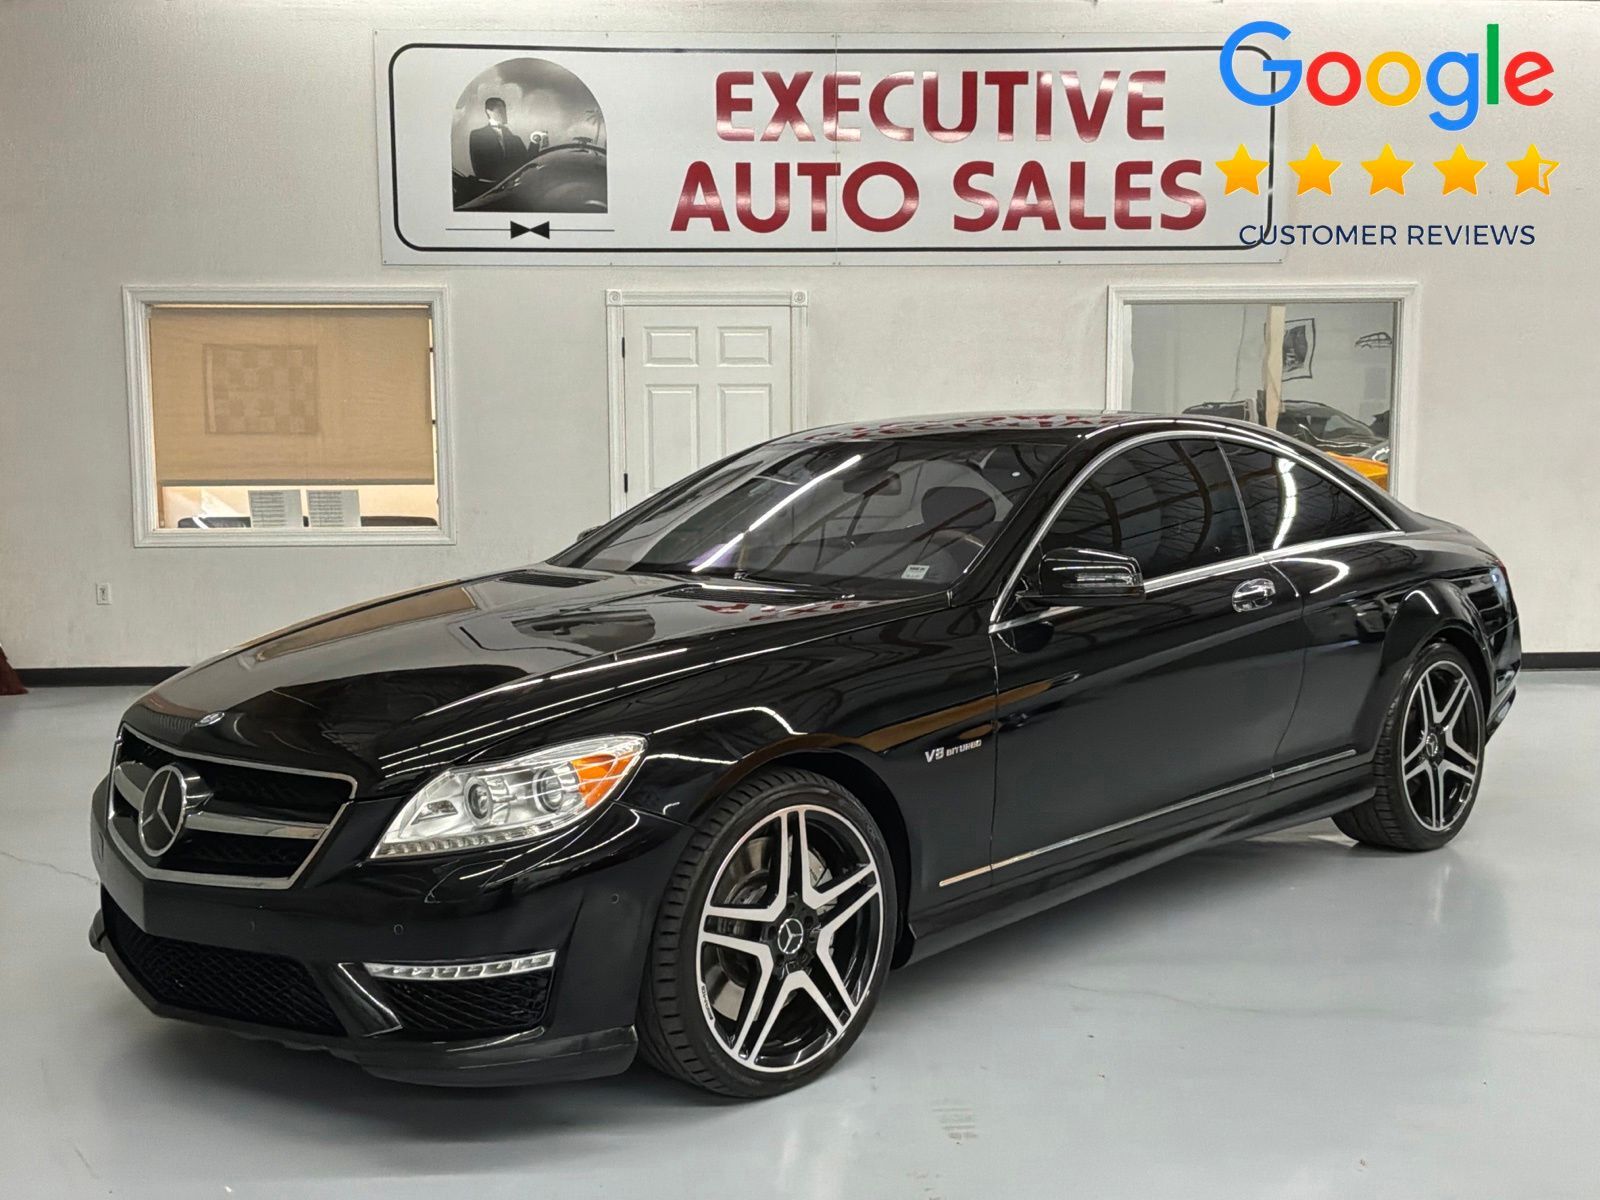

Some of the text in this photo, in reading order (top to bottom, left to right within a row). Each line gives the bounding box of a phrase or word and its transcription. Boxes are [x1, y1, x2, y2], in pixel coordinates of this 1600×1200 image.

[715, 70, 1166, 142] EXECUTIVE
[670, 159, 1207, 234] AUTO SALES
[924, 746, 945, 763] V8
